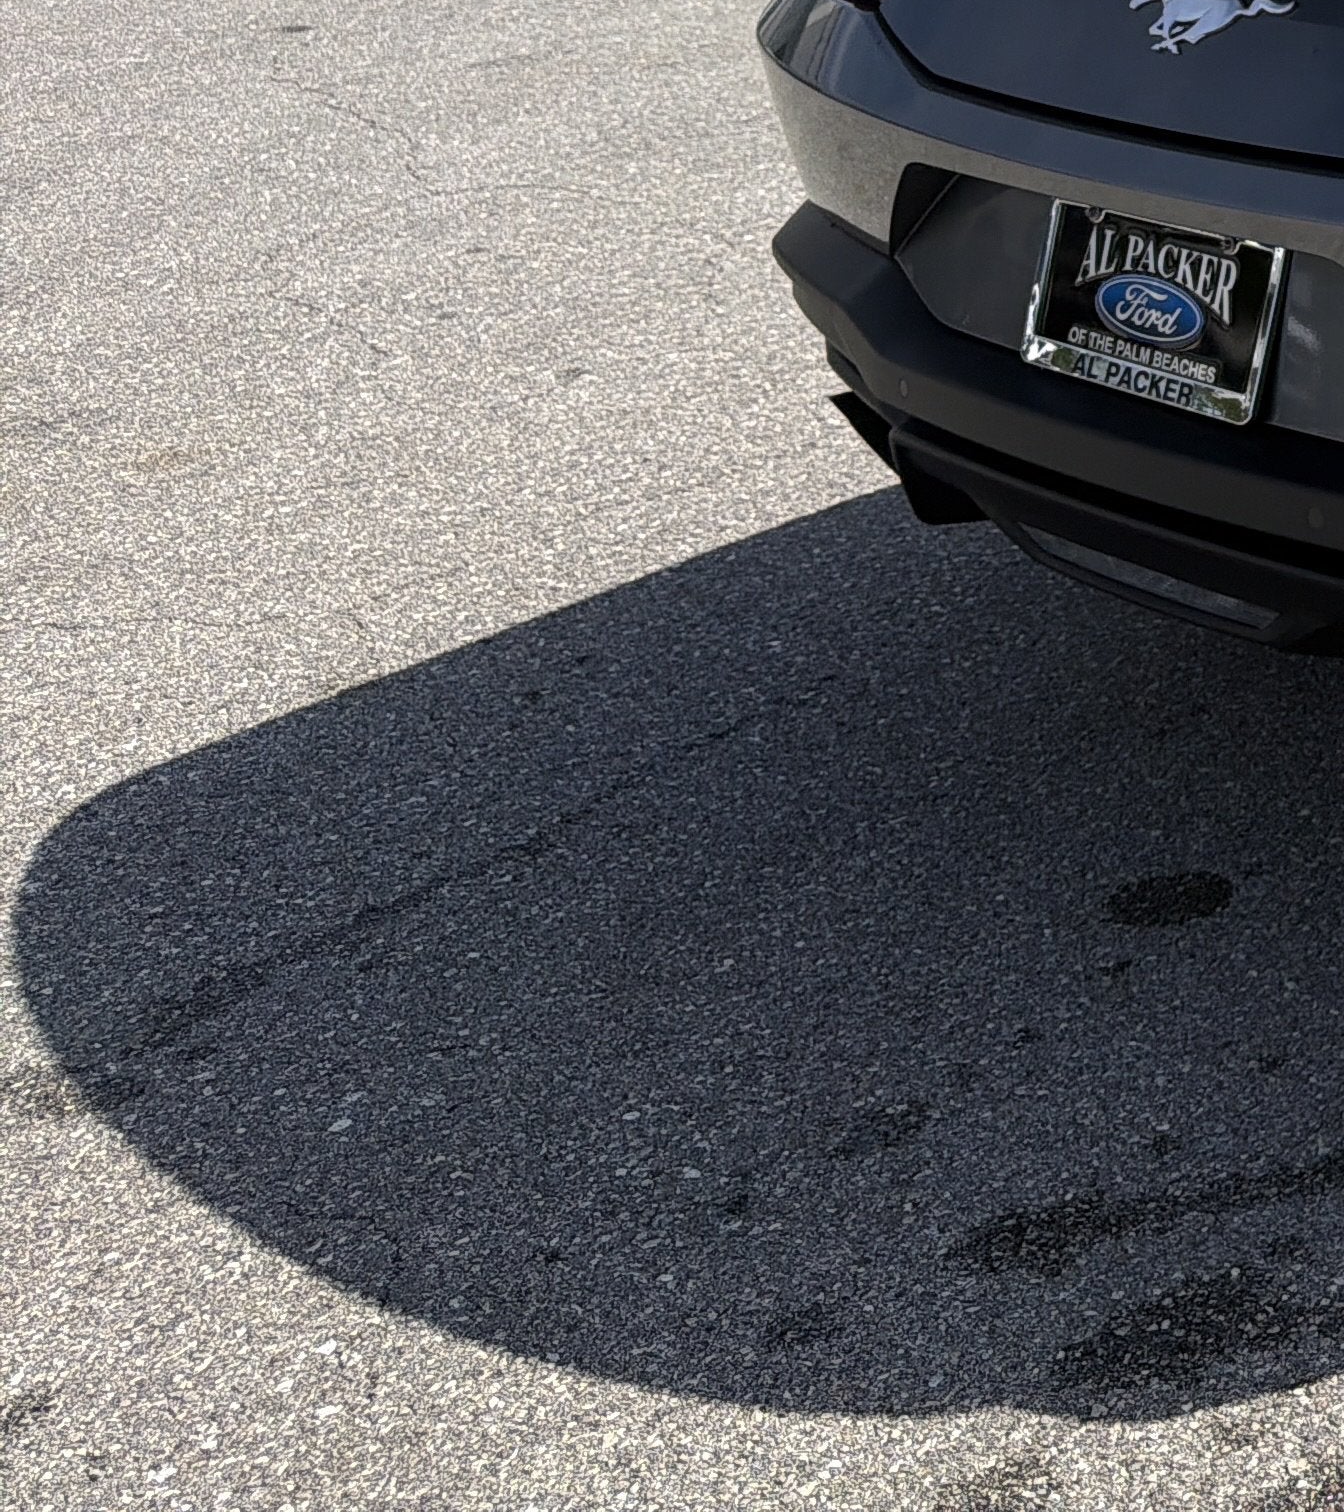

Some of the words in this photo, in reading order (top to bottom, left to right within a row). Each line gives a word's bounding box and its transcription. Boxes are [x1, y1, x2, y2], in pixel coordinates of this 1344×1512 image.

[1075, 225, 1116, 286] AL
[1123, 235, 1238, 326] PACKER
[1115, 284, 1183, 335] Ford
[1068, 326, 1087, 344] OF
[1088, 331, 1114, 352] THE
[1114, 338, 1149, 363] PALM
[1153, 349, 1217, 383] BEACHES
[1071, 353, 1096, 380] AL
[1104, 361, 1193, 407] PACKER
